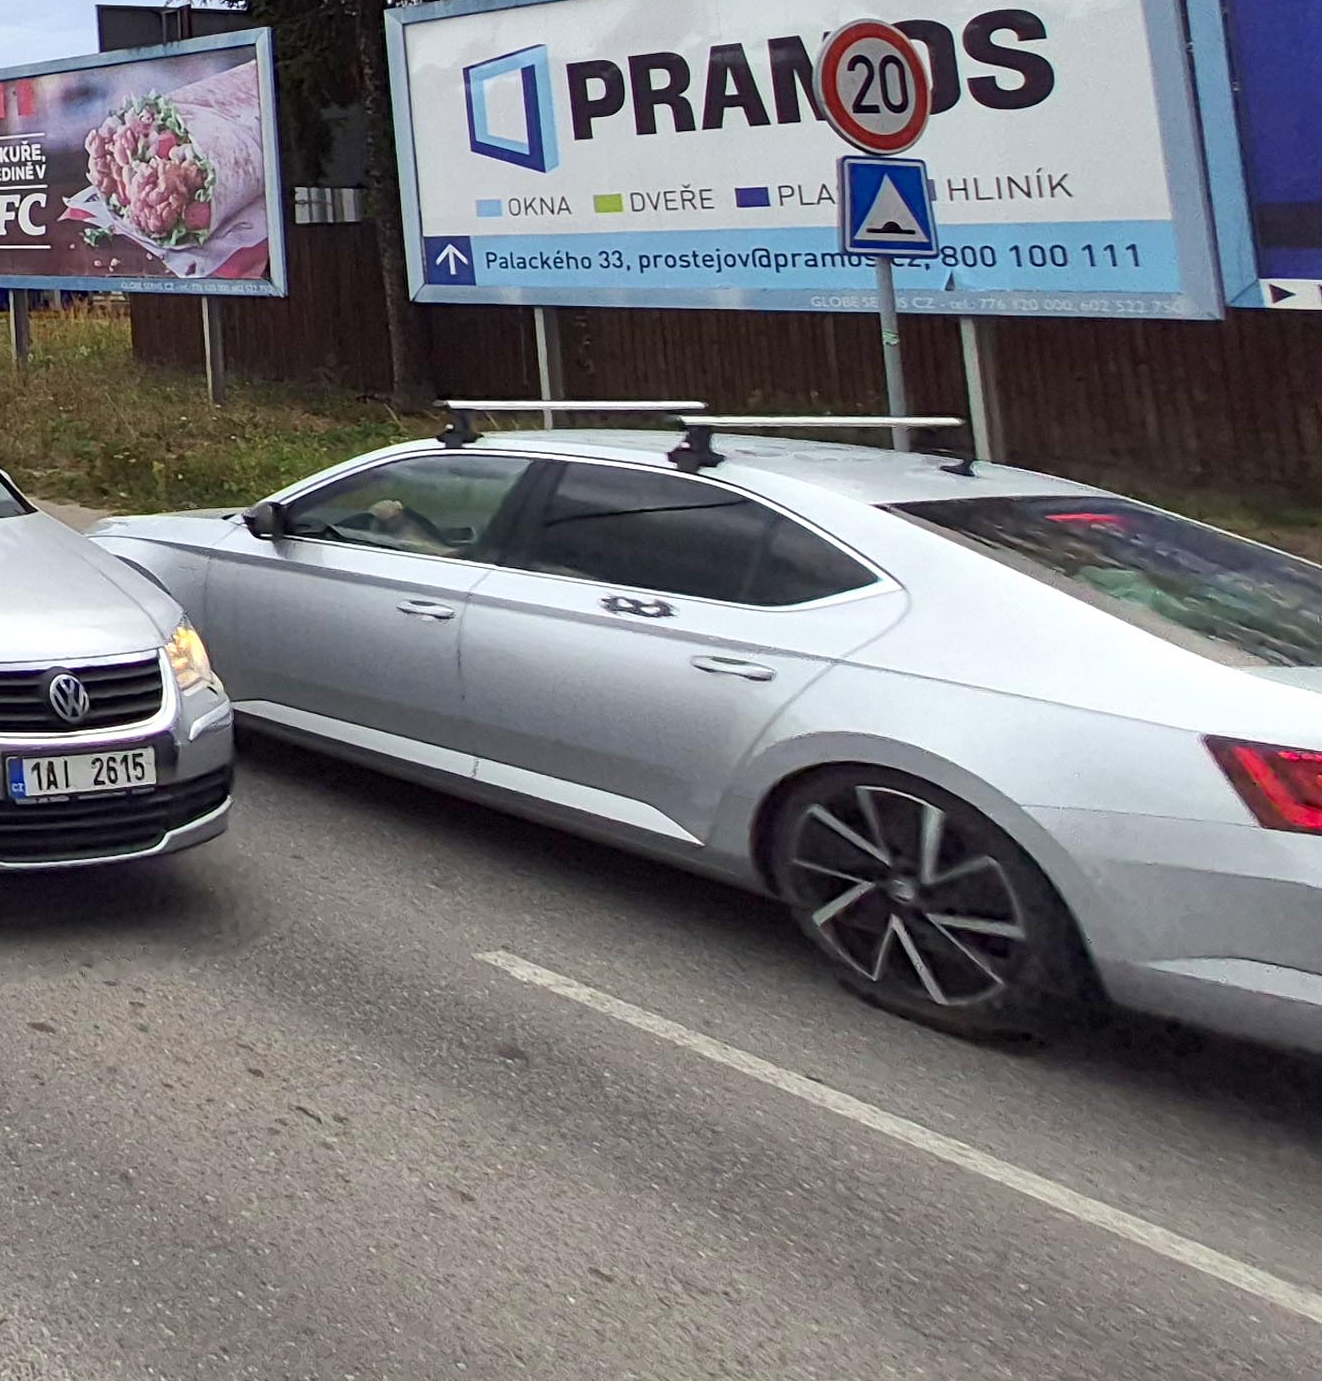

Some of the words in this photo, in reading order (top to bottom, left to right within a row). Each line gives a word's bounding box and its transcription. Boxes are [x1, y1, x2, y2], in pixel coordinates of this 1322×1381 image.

[846, 54, 909, 114] 20
[35, 164, 46, 180] V
[508, 195, 573, 217] OKNA
[629, 184, 716, 214] DVEŘE
[777, 183, 839, 207] PLA
[947, 167, 1075, 203] HLINÍK
[485, 250, 593, 271] Palackého
[598, 250, 632, 272] 33,
[940, 244, 998, 268] 800
[1009, 243, 1068, 268] 100
[1081, 242, 1142, 268] 111
[912, 297, 936, 309] CZ
[90, 752, 146, 787] 2615
